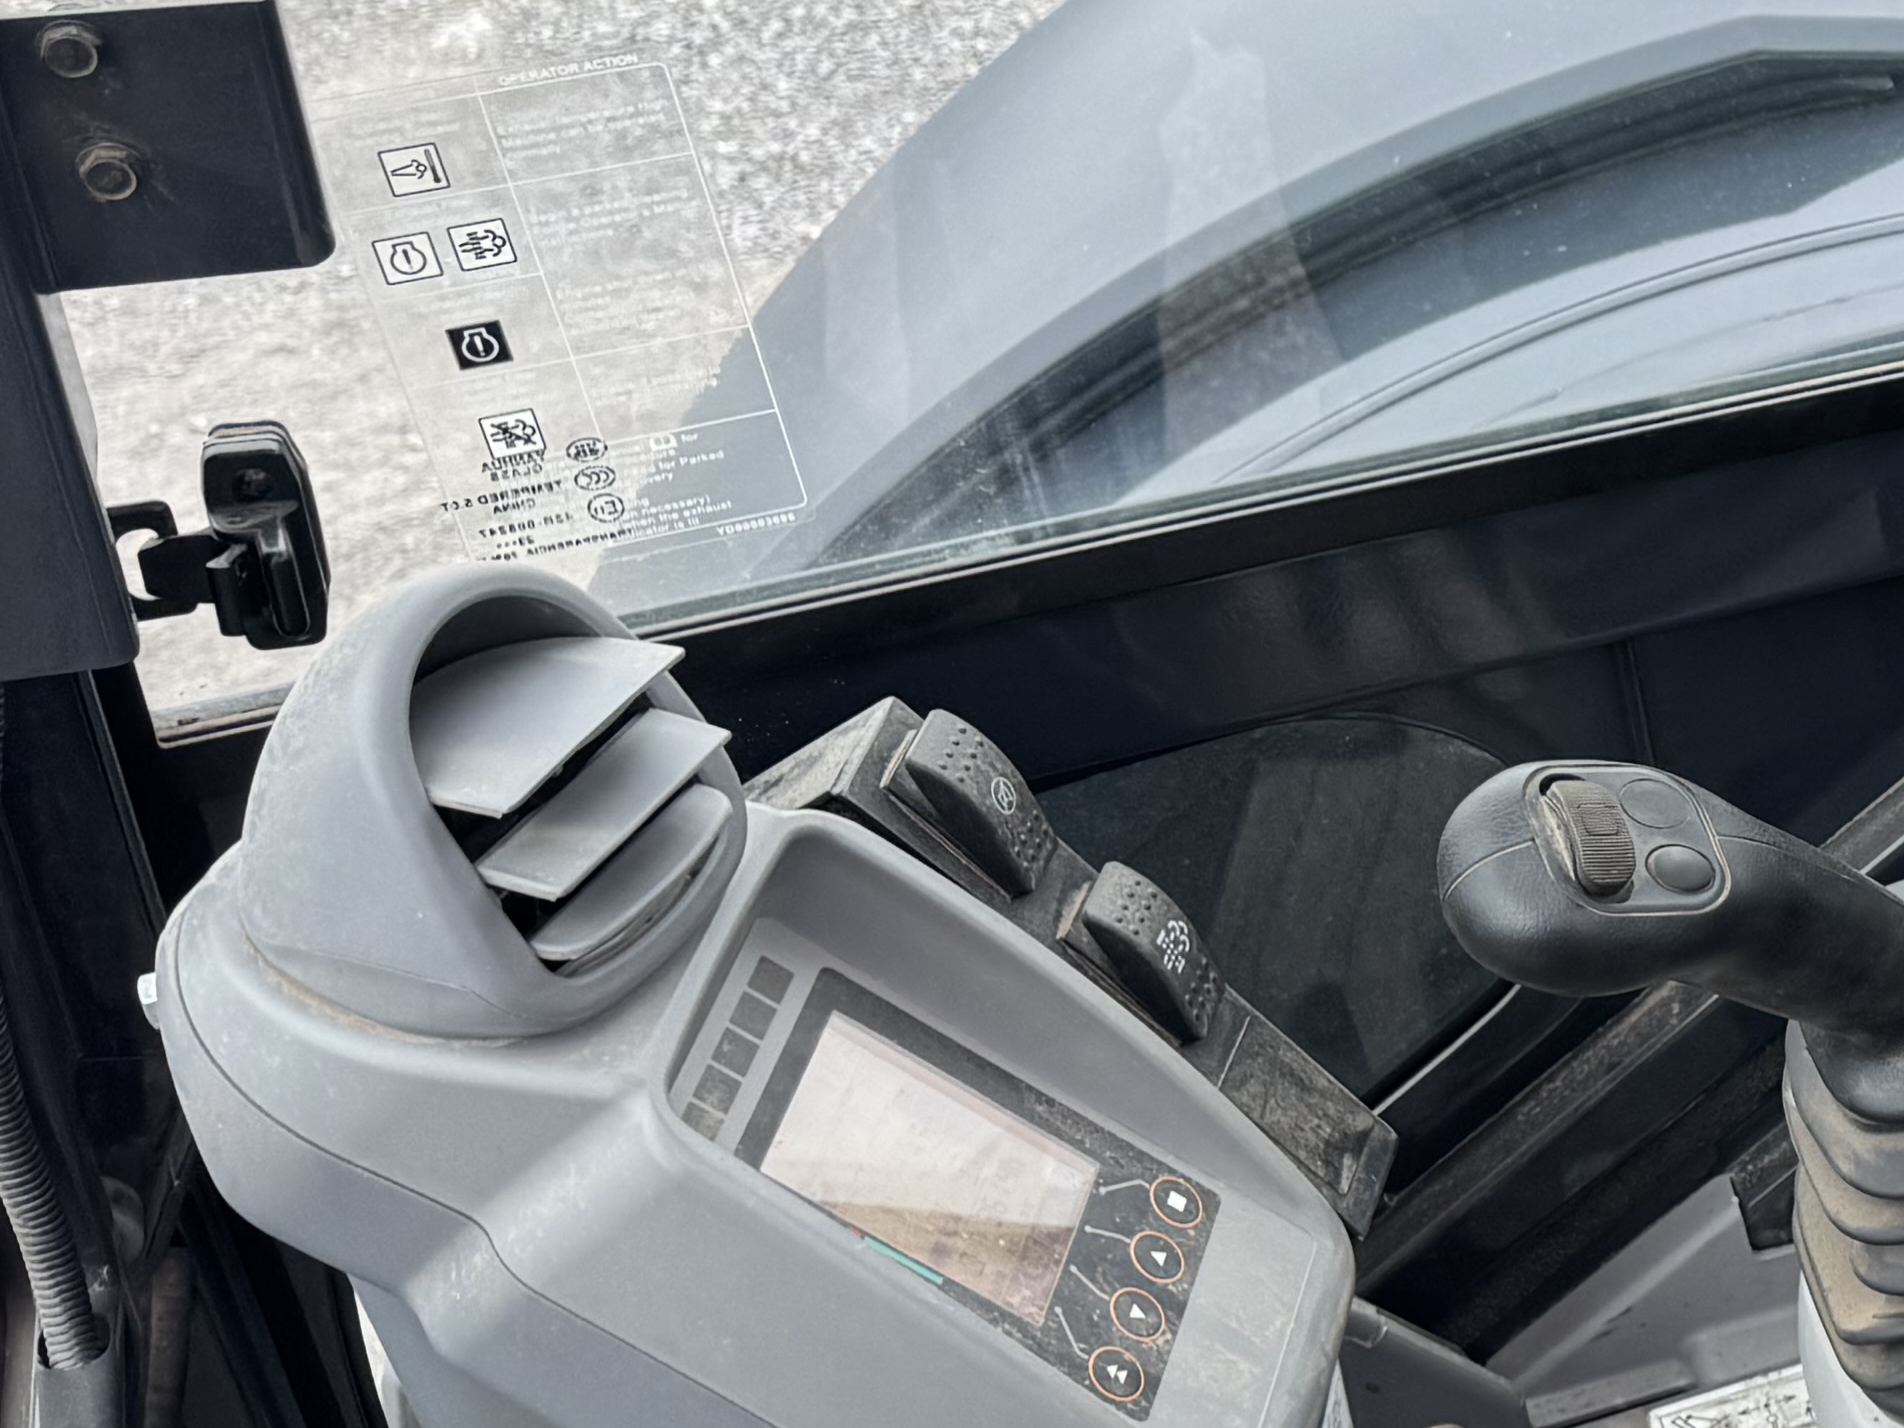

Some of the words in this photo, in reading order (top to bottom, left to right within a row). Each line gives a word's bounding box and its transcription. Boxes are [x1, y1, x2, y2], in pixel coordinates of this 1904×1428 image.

[500, 63, 580, 86] OPERATOR
[584, 53, 639, 71] ACTION
[681, 433, 698, 444] for
[658, 460, 676, 471] for
[680, 449, 724, 467] Parked
[642, 494, 710, 514] necessary)
[658, 510, 679, 522] the
[683, 500, 732, 518] exhaust
